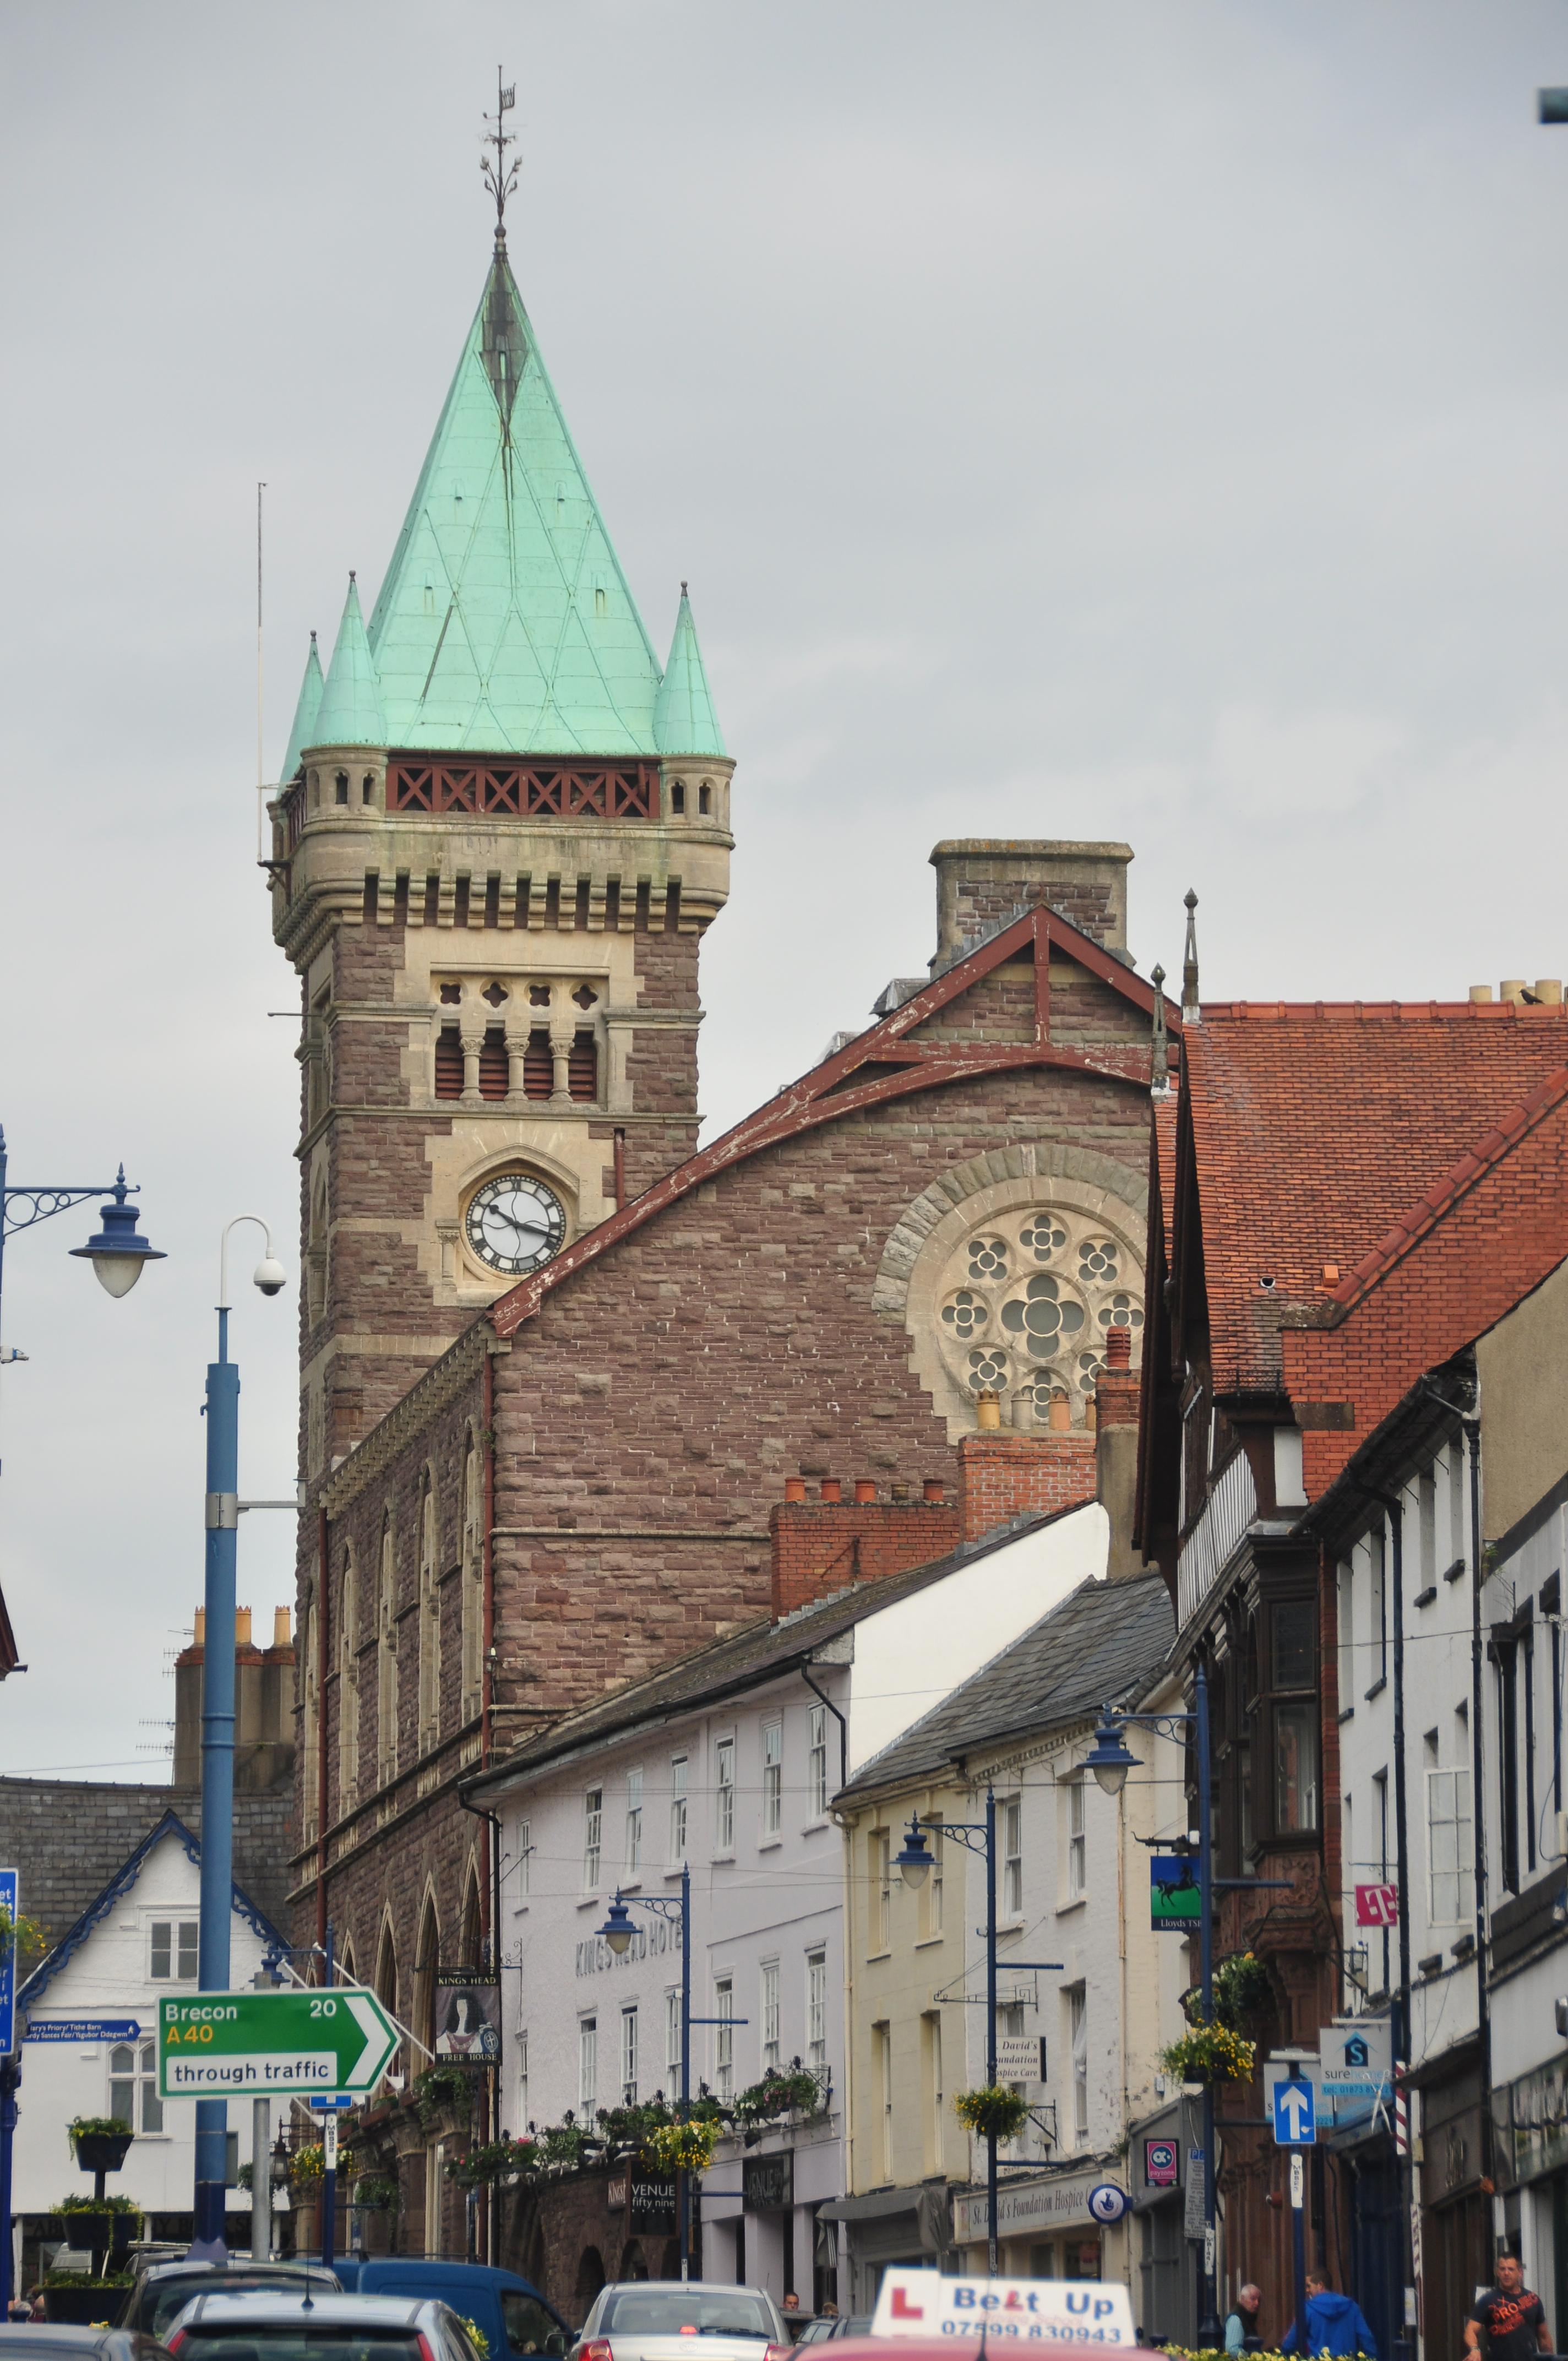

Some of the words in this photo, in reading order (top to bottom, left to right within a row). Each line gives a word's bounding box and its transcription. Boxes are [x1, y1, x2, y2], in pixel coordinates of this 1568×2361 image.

[1161, 1919, 1186, 1929] Lloyds
[576, 1936, 612, 1976] KINGS
[650, 1916, 683, 1956] HOTE
[439, 1977, 467, 1985] KINGS
[166, 2004, 237, 2021] Brecon
[310, 2000, 336, 2017] 20
[1003, 2041, 1037, 2049] David's
[998, 2055, 1038, 2064] undation
[175, 2063, 257, 2083] through
[264, 2061, 329, 2079] traffic
[997, 2069, 1018, 2079] spice
[631, 2184, 676, 2196] VENUE
[632, 2197, 652, 2209] fifty
[655, 2198, 675, 2207] nine
[984, 2196, 1010, 2223] Did's
[1013, 2193, 1052, 2218] Foundation
[1055, 2187, 1084, 2215] Hospice
[891, 2287, 923, 2320] L
[1066, 2292, 1114, 2320] Up
[941, 2320, 1019, 2336] 07599
[1027, 2323, 1121, 2344] 830943
